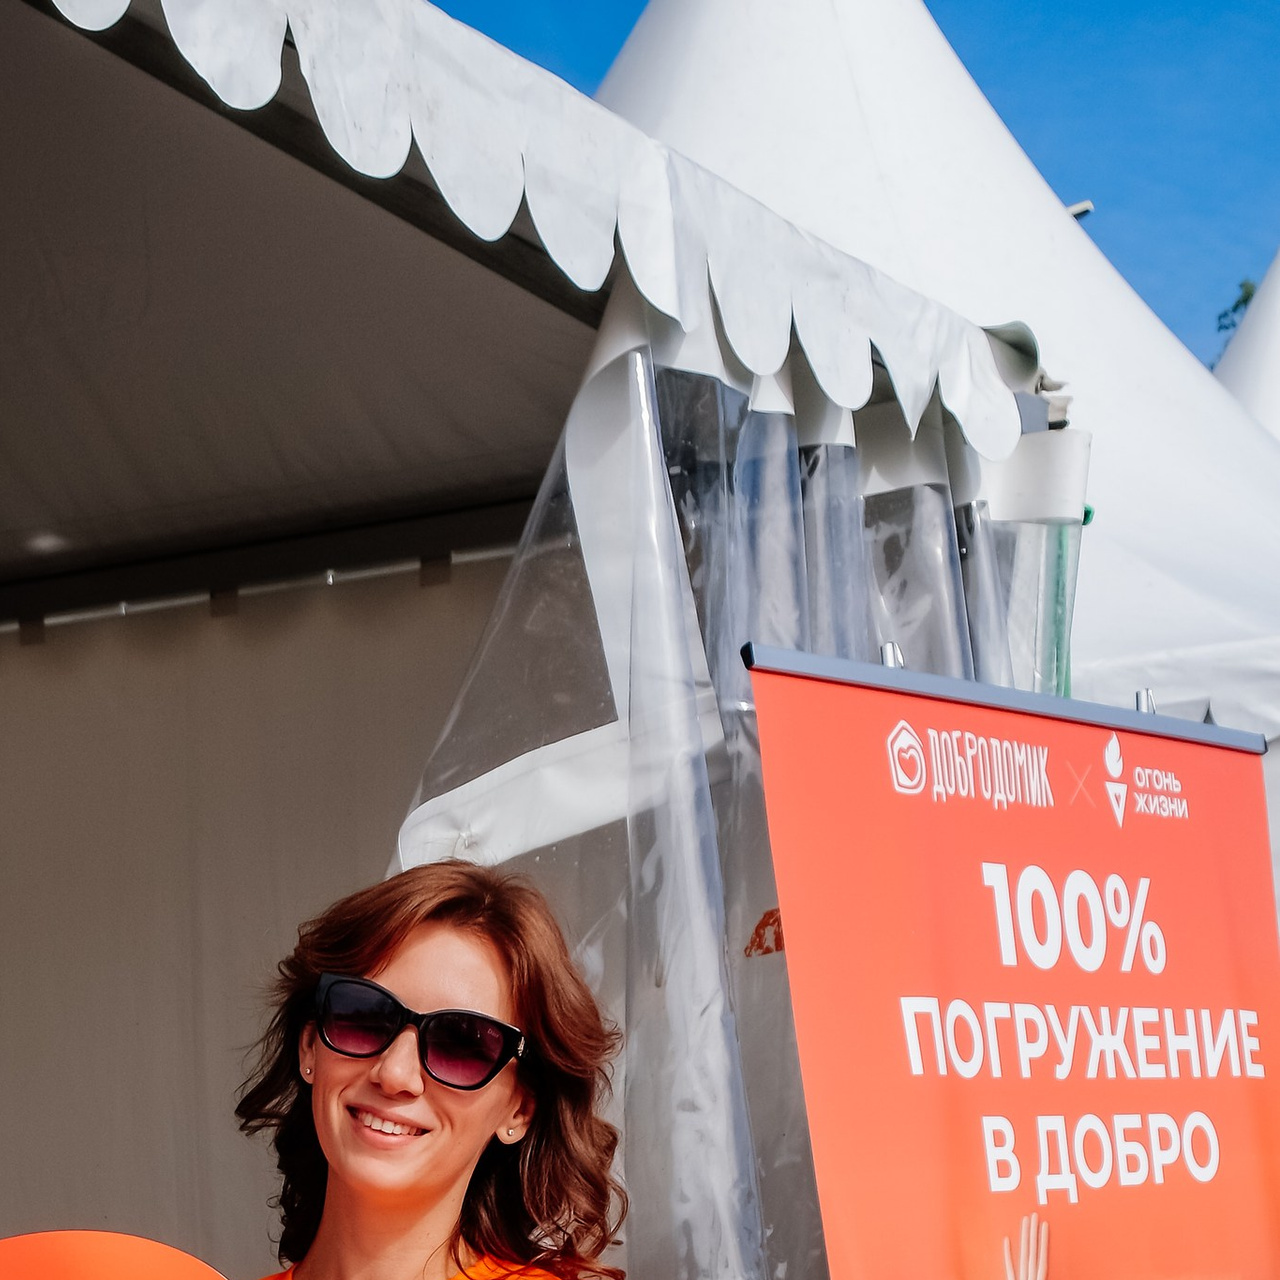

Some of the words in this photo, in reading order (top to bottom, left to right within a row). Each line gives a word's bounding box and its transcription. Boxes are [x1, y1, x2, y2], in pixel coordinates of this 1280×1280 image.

[927, 728, 1055, 811] ДОБРОДОМИК
[1134, 765, 1183, 794] ОГОНЬ
[1134, 792, 1190, 820] ЖИЗНИ
[981, 861, 1168, 975] 100%
[900, 996, 1267, 1081] ПОГРУЖЕНИЕ
[981, 1115, 1021, 1193] В
[1036, 1111, 1220, 1206] ДОБРО
